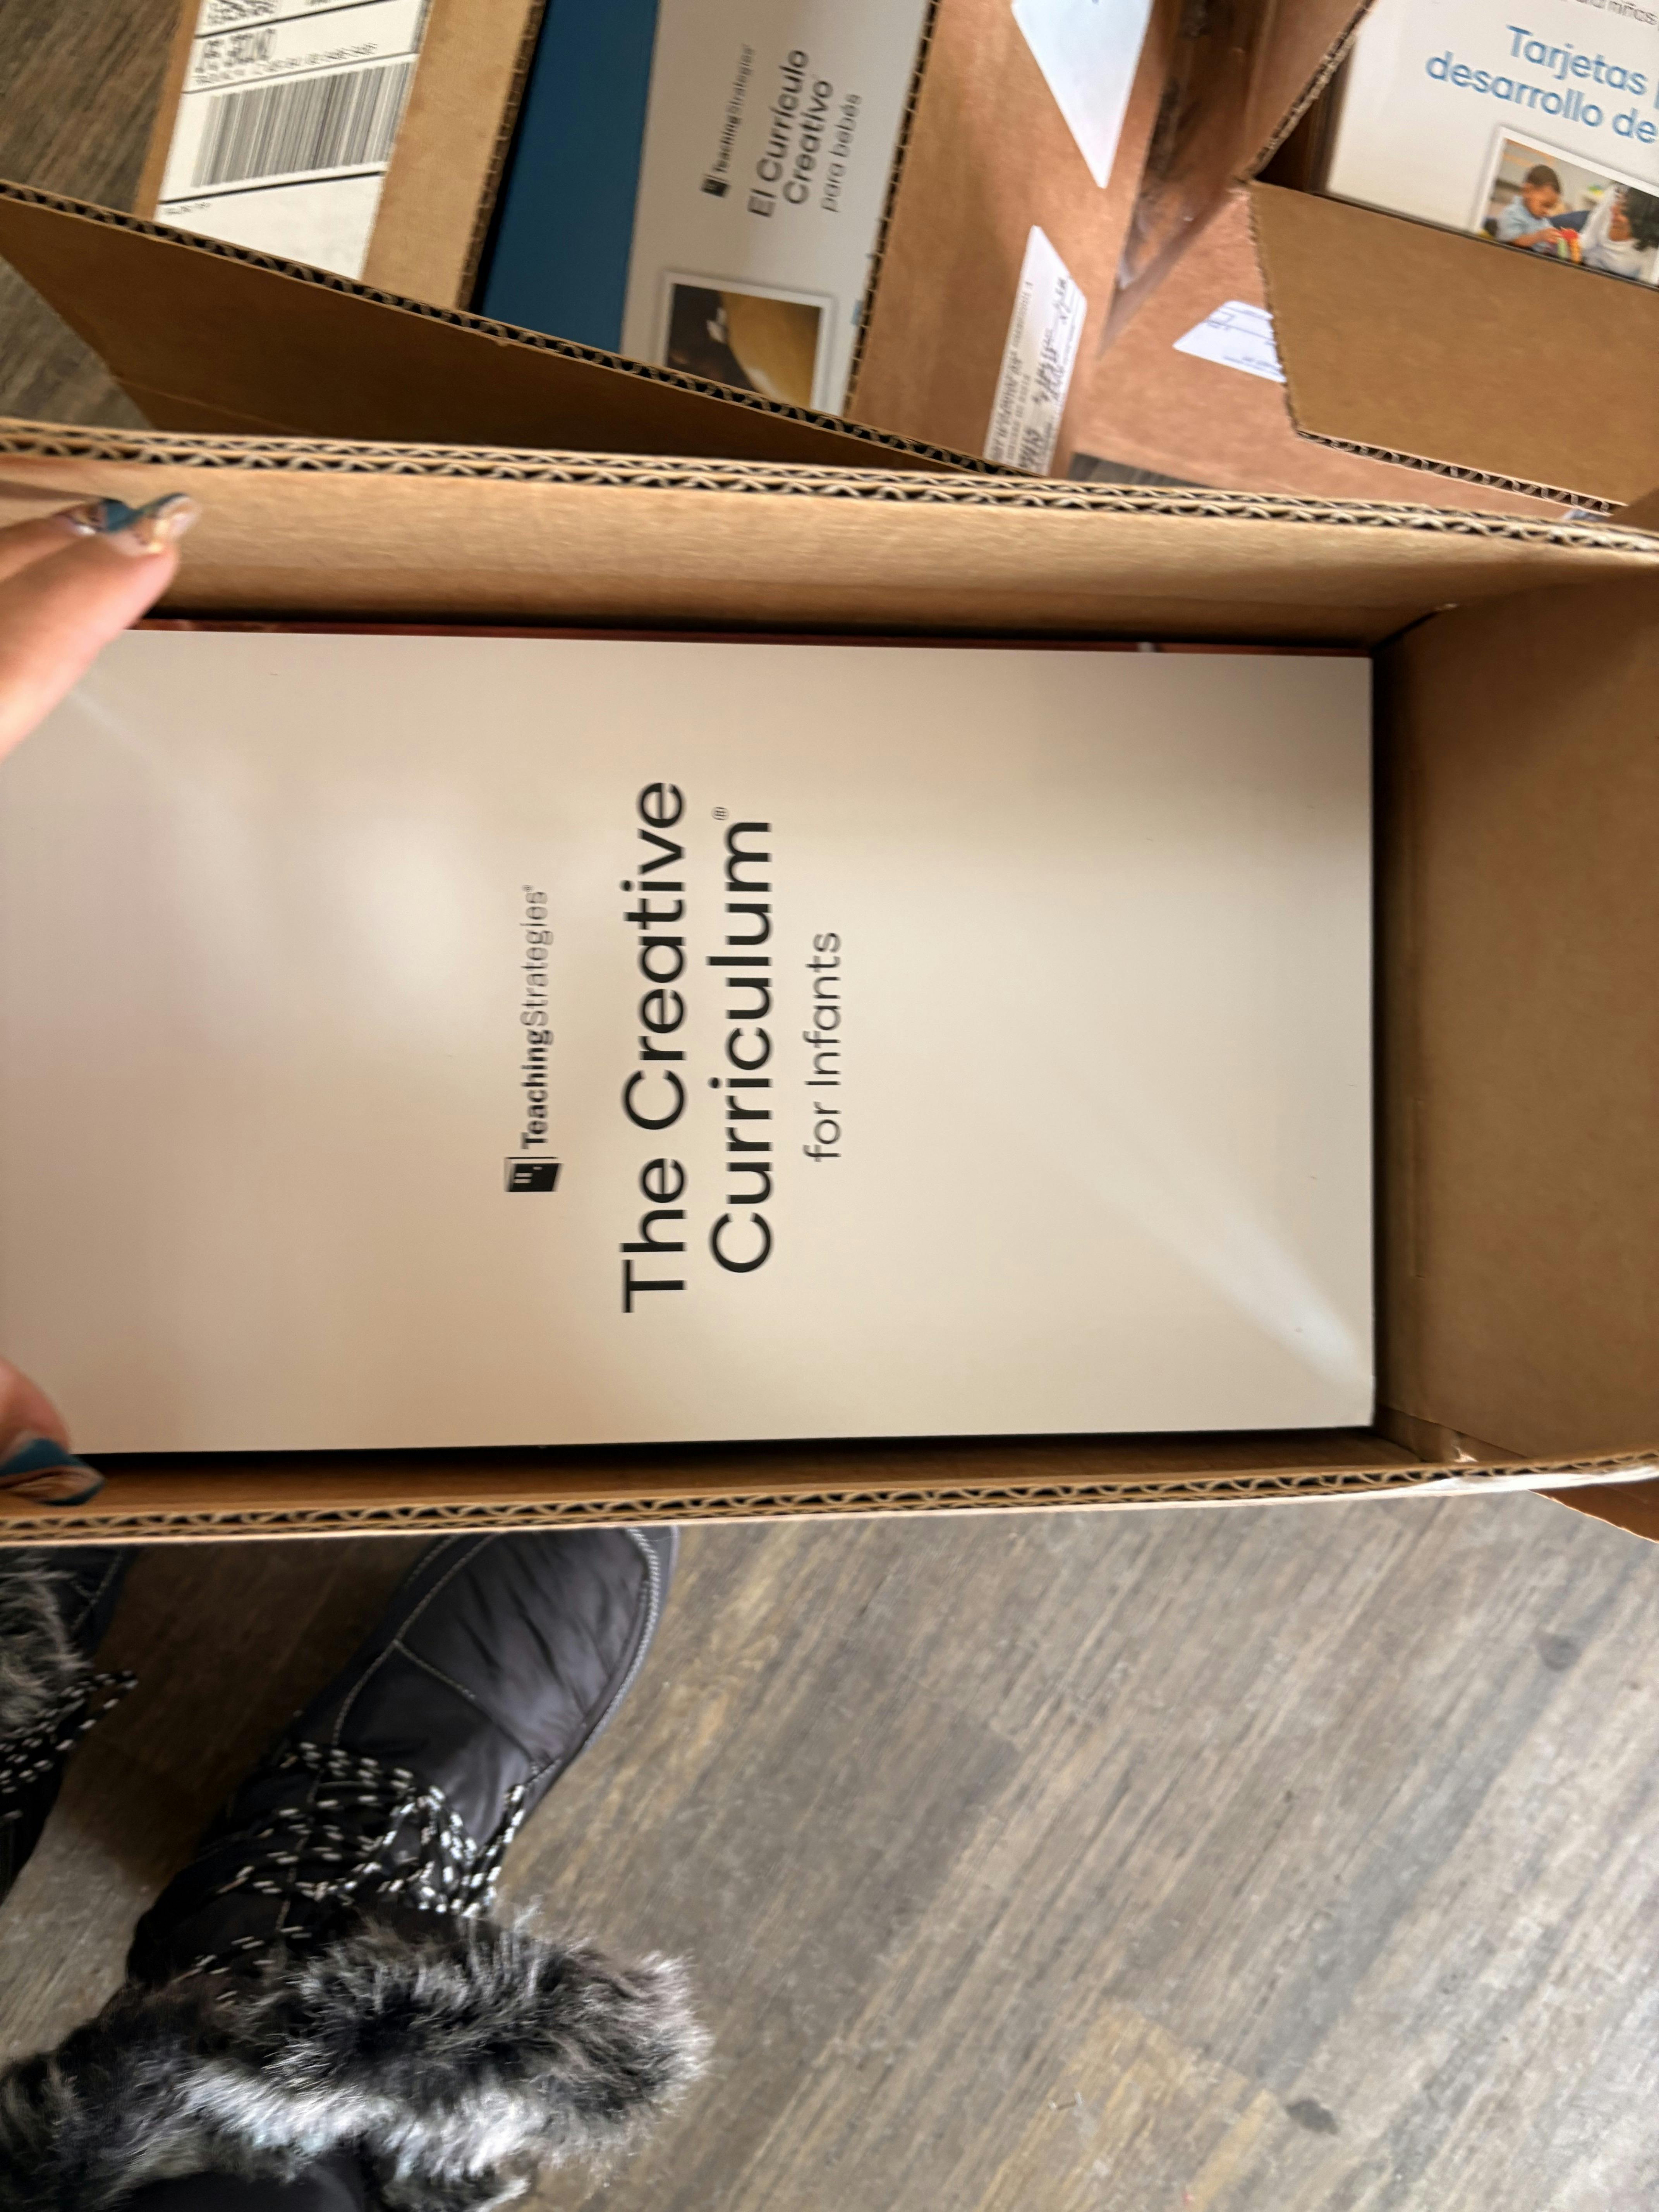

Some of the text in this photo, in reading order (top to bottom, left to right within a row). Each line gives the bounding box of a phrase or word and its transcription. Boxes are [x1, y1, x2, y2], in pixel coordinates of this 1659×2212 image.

[1425, 50, 1604, 127] desarrollo
[1612, 107, 1659, 144] de
[1505, 24, 1648, 96] Tarjetas
[782, 80, 834, 205] Creativo
[820, 163, 847, 213] para
[746, 187, 776, 218] El
[619, 781, 687, 1313] The Creative
[802, 932, 842, 1163] for Infants
